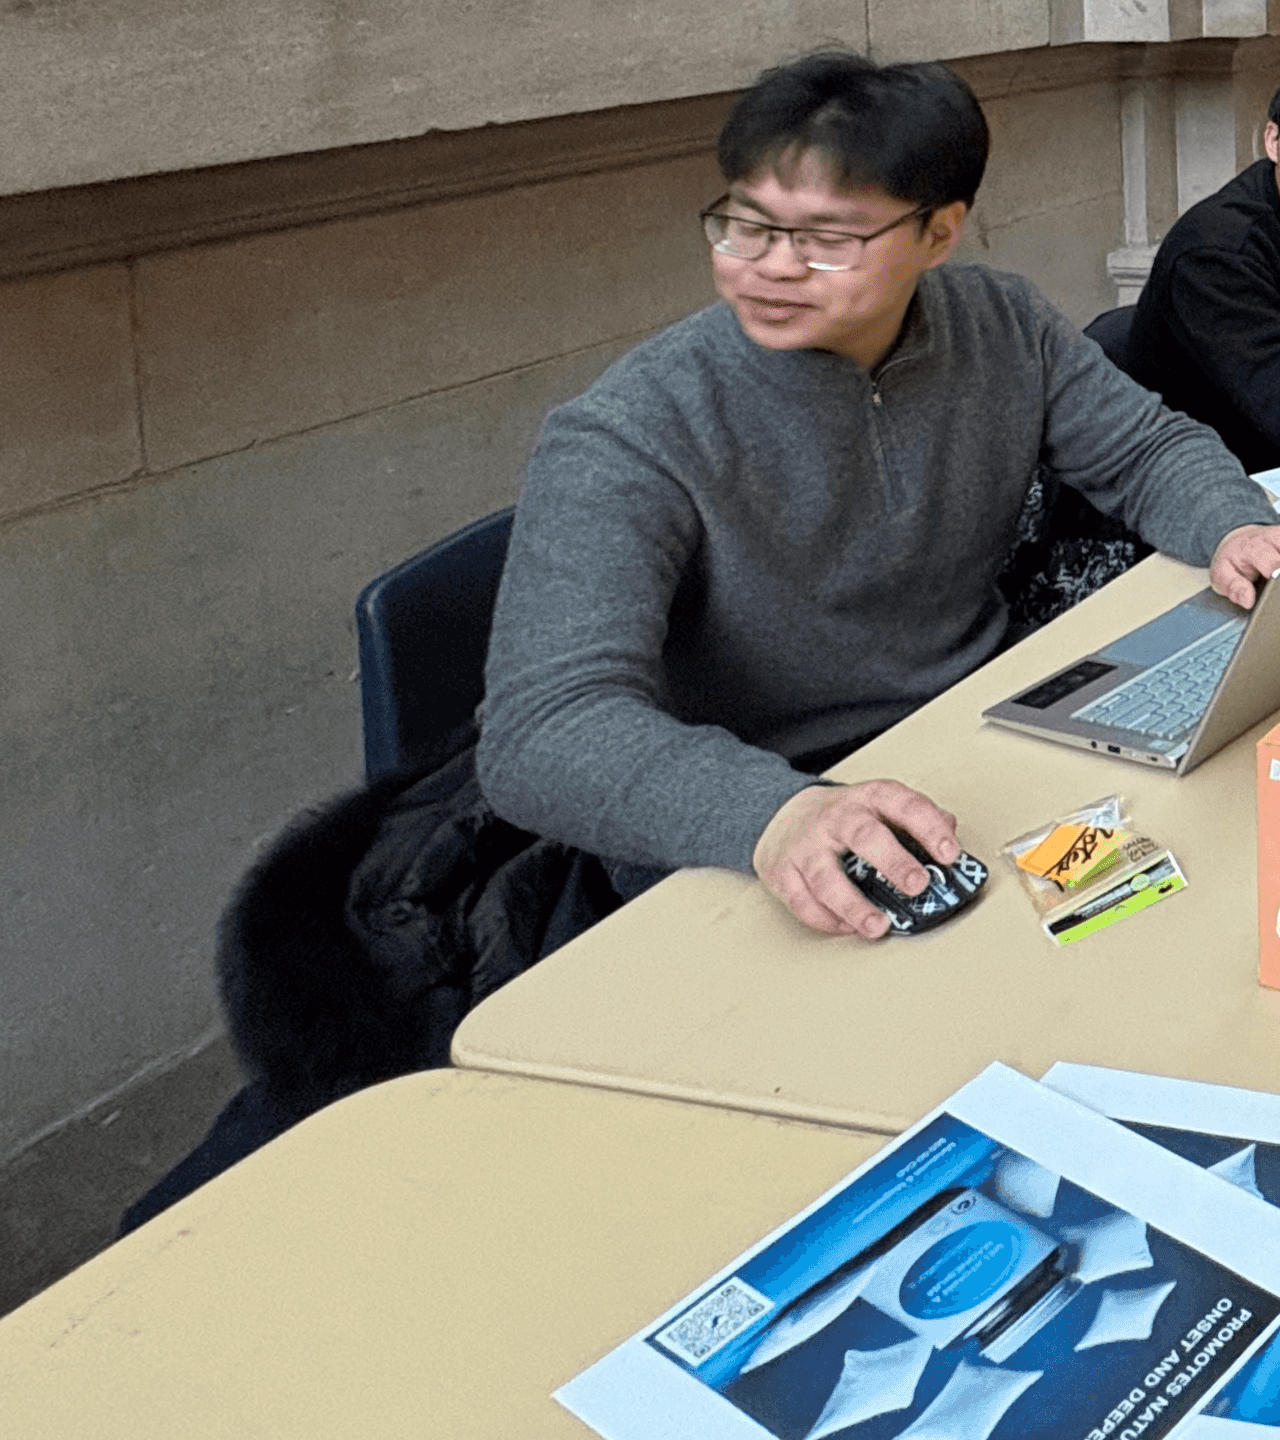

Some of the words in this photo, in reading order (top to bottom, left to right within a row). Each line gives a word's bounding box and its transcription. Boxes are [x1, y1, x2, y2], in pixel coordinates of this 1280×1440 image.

[1165, 1308, 1253, 1398] PROMOTES
[1180, 1297, 1233, 1353] ONSET
[1143, 1349, 1180, 1388] AND
